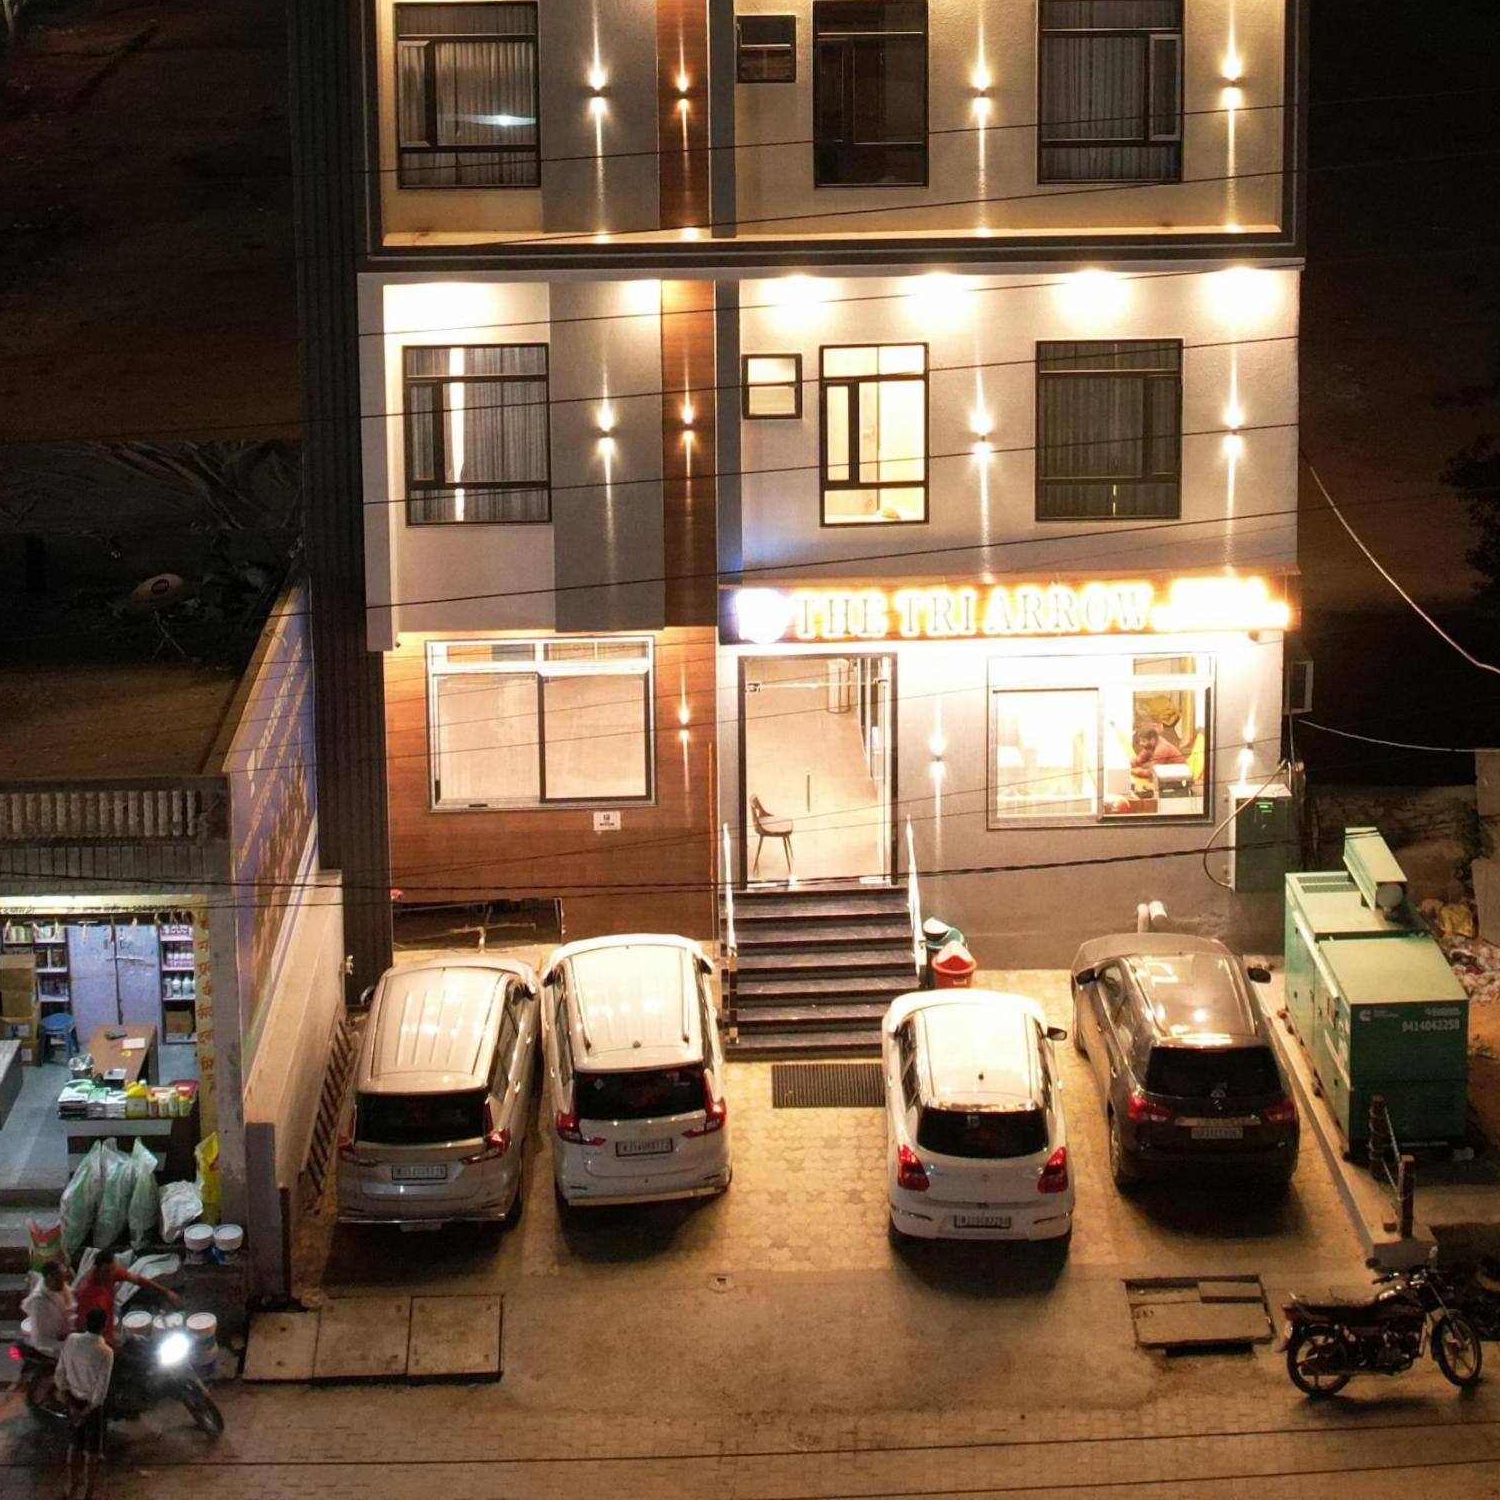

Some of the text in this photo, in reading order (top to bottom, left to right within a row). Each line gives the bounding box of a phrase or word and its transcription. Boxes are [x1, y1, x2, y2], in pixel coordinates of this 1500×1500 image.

[792, 589, 888, 639] THE
[896, 588, 977, 637] TRI
[984, 582, 1153, 634] ARROW
